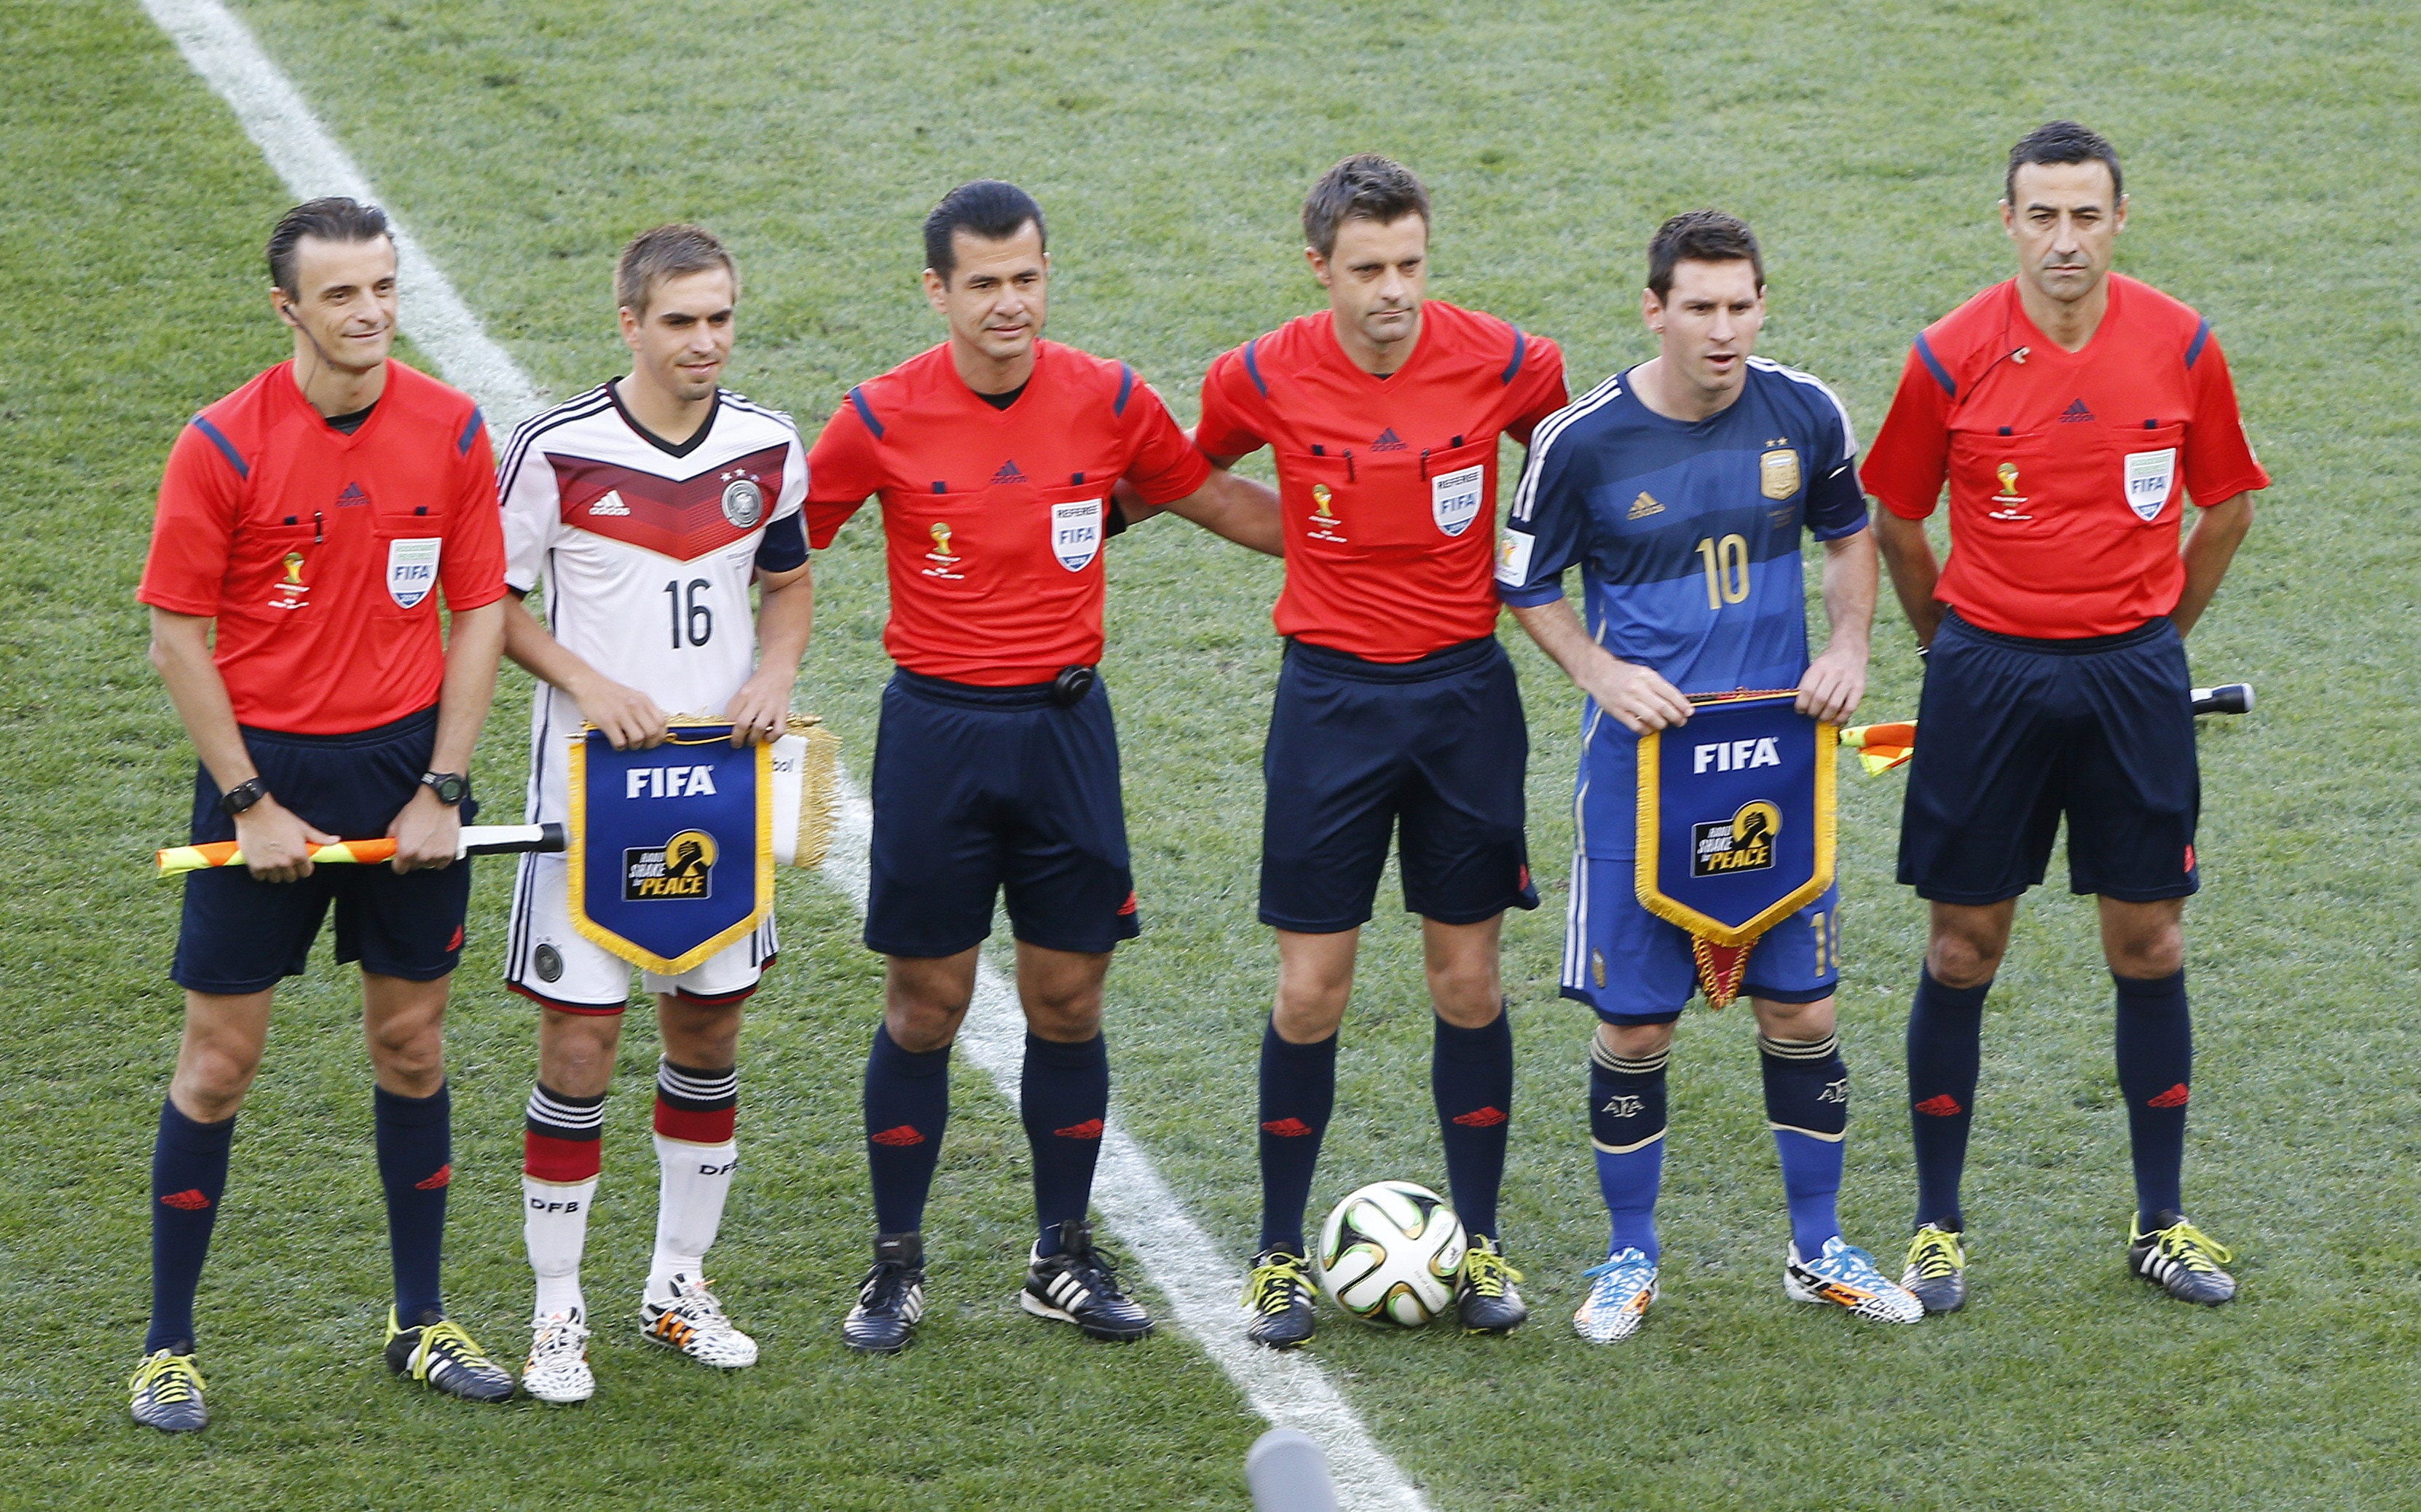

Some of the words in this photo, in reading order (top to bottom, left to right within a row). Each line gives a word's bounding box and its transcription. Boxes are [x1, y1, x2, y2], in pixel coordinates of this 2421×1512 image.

[2132, 475, 2168, 495] FIFA
[1057, 505, 1098, 519] REFEREE
[1440, 492, 1477, 514] FIFA
[1060, 526, 1095, 545] FIFA
[394, 565, 430, 580] FIFA
[1694, 534, 1751, 610] 10
[663, 578, 713, 649] 16
[1693, 737, 1782, 774] FIFA
[626, 765, 717, 799] FIFA
[1706, 846, 1770, 871] PEACE
[639, 875, 705, 897] PEACE
[530, 1198, 578, 1213] DFB
